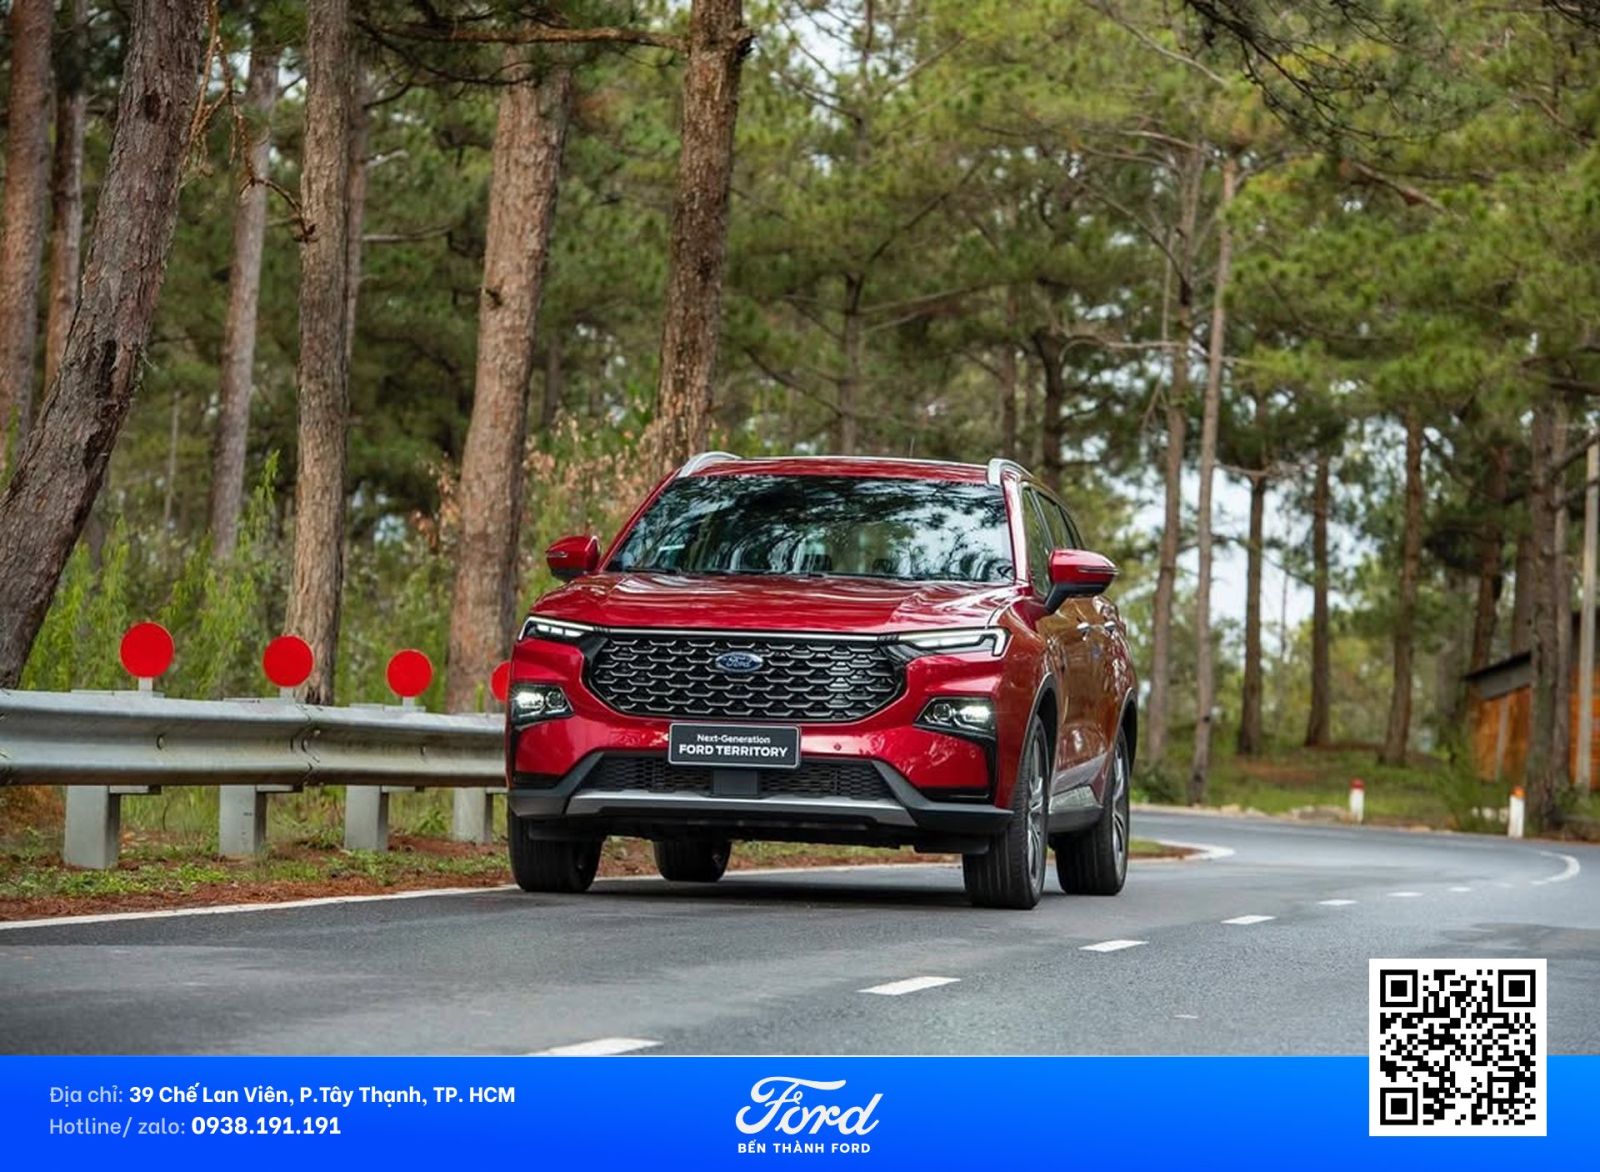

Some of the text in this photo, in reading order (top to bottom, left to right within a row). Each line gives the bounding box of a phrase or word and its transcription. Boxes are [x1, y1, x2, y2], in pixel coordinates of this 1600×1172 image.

[724, 656, 753, 668] Ford
[697, 734, 771, 744] Next-Generation
[679, 744, 788, 757] FORD TERRITORY
